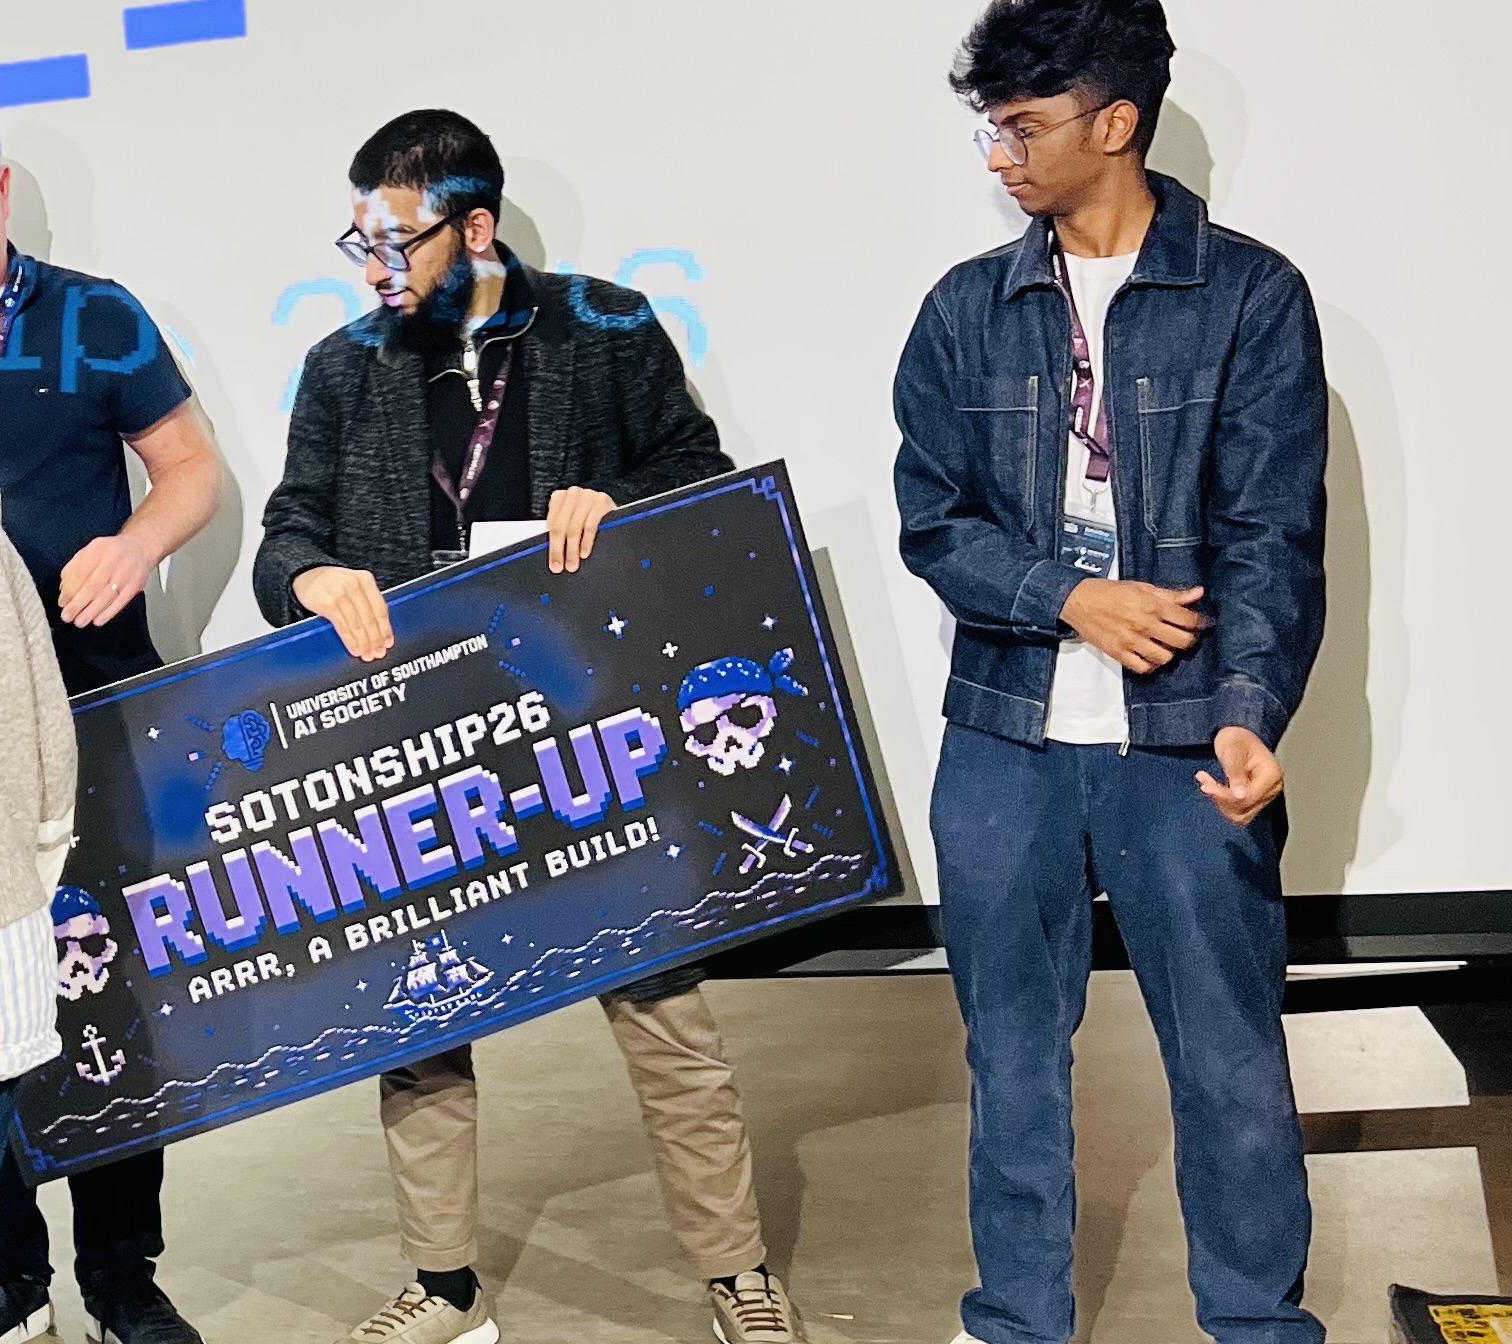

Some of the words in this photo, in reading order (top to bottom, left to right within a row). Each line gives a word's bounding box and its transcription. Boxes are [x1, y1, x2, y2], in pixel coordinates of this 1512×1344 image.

[286, 678, 368, 719] UNIVERSITY
[370, 671, 390, 690] OF
[392, 633, 488, 682] SOUTHAMPTON
[294, 715, 317, 740] AI
[319, 682, 407, 729] SOCIETY
[121, 706, 668, 979] RUNNER-UP
[204, 690, 551, 844] SOTONSHIP26
[188, 952, 296, 1003] ARRR,
[308, 935, 333, 964] A
[345, 862, 531, 952] BRILLIANT
[546, 816, 662, 878] BUILD!
